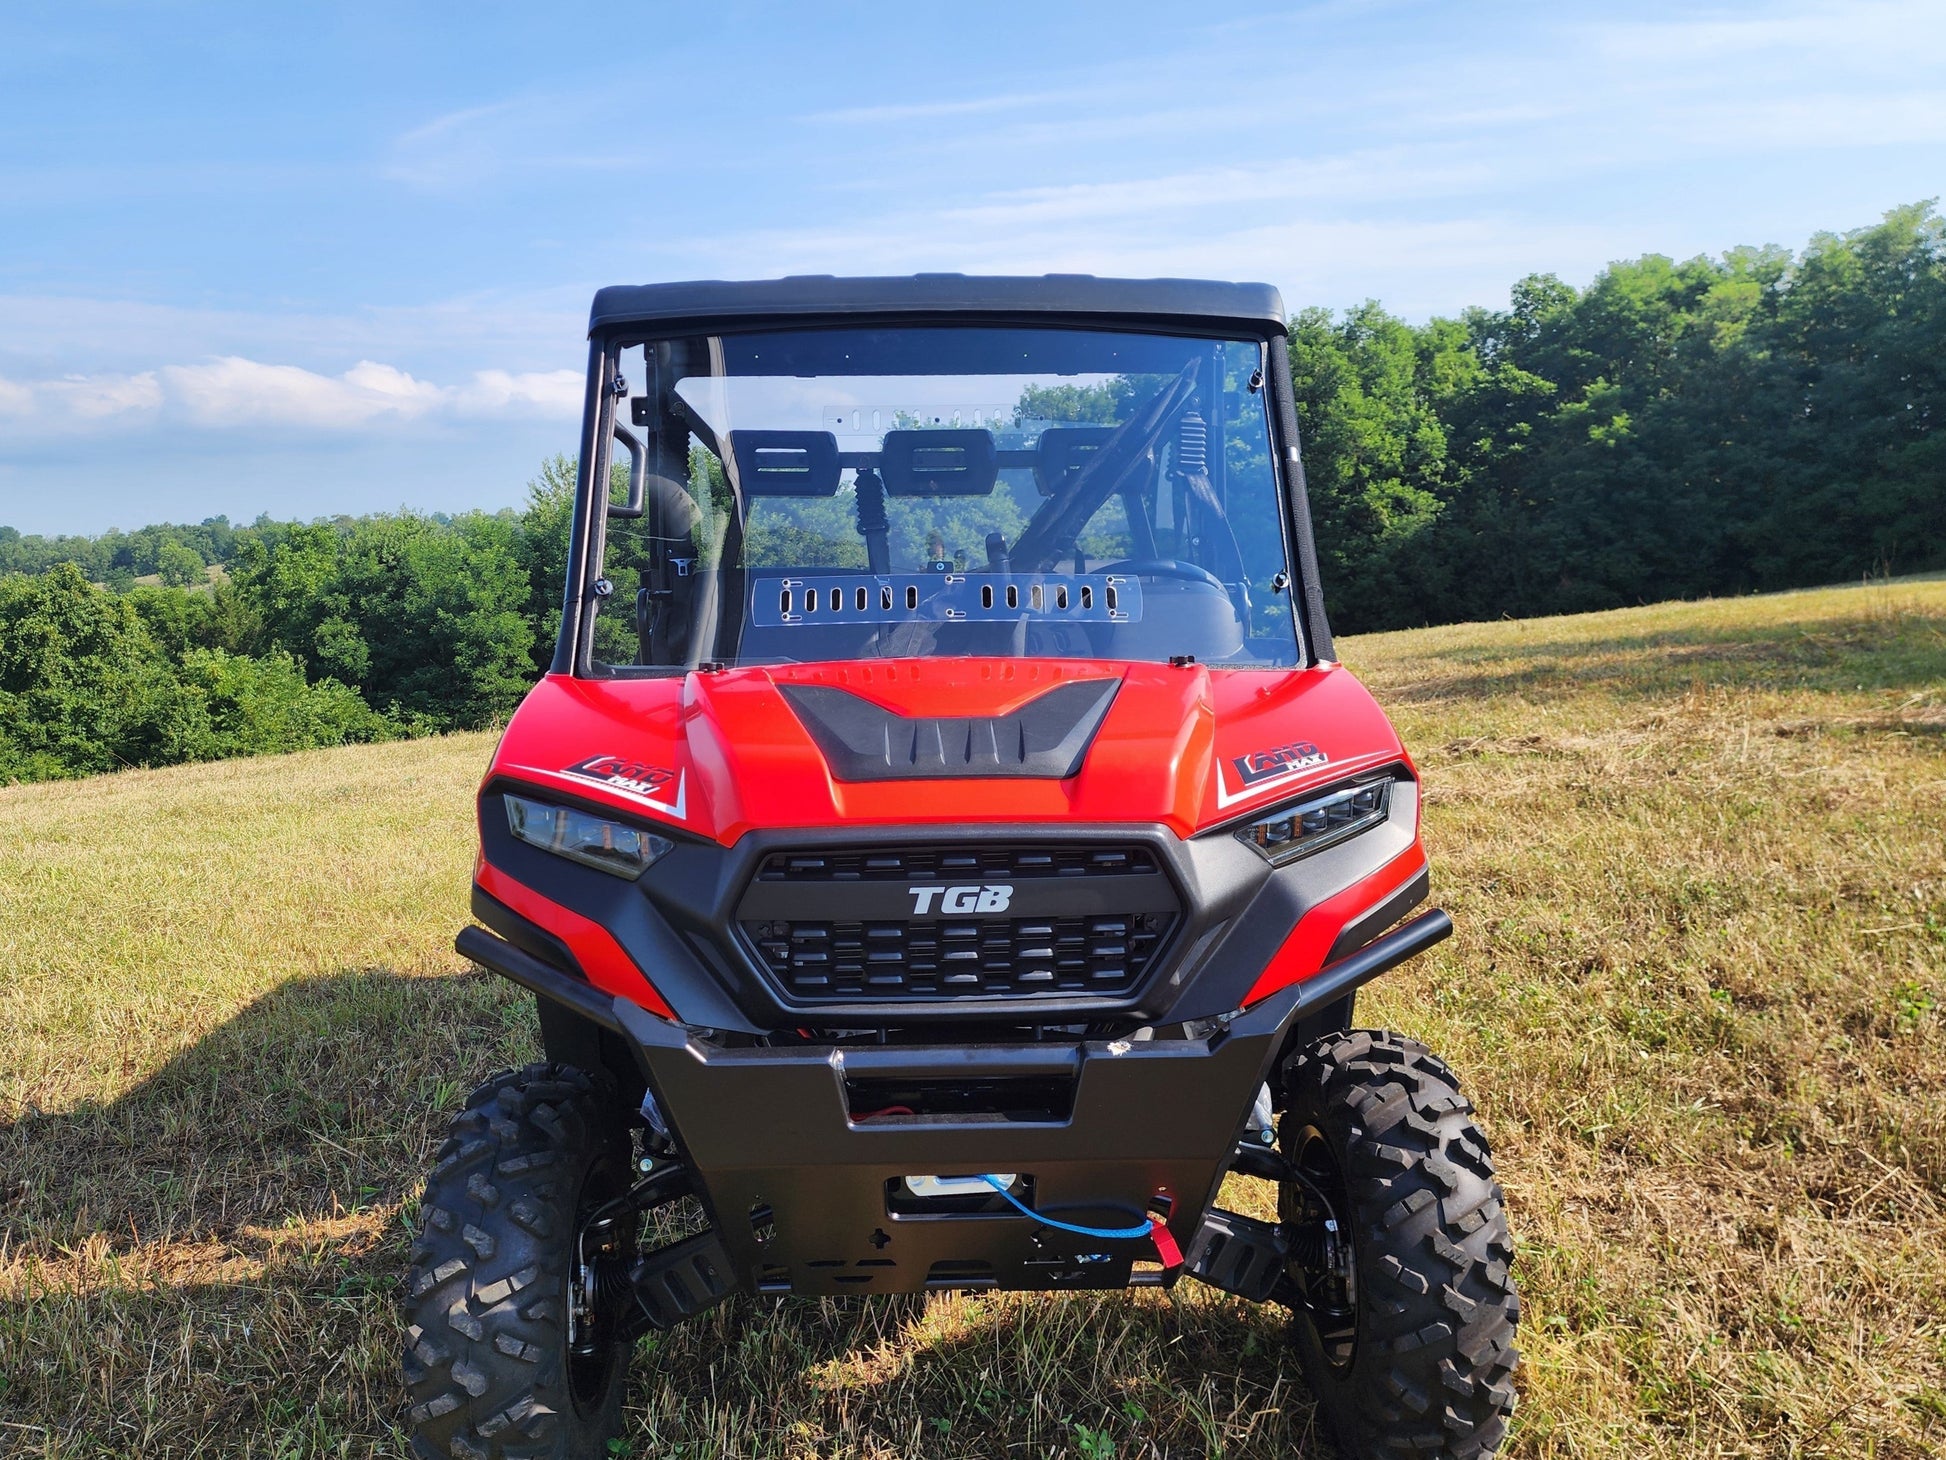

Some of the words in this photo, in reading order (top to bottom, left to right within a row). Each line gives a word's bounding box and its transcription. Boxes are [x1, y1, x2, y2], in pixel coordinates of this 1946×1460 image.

[1232, 740, 1319, 785] LAND
[1286, 753, 1326, 770] MAX
[607, 775, 655, 792] MAX
[909, 885, 1014, 914] TGB
